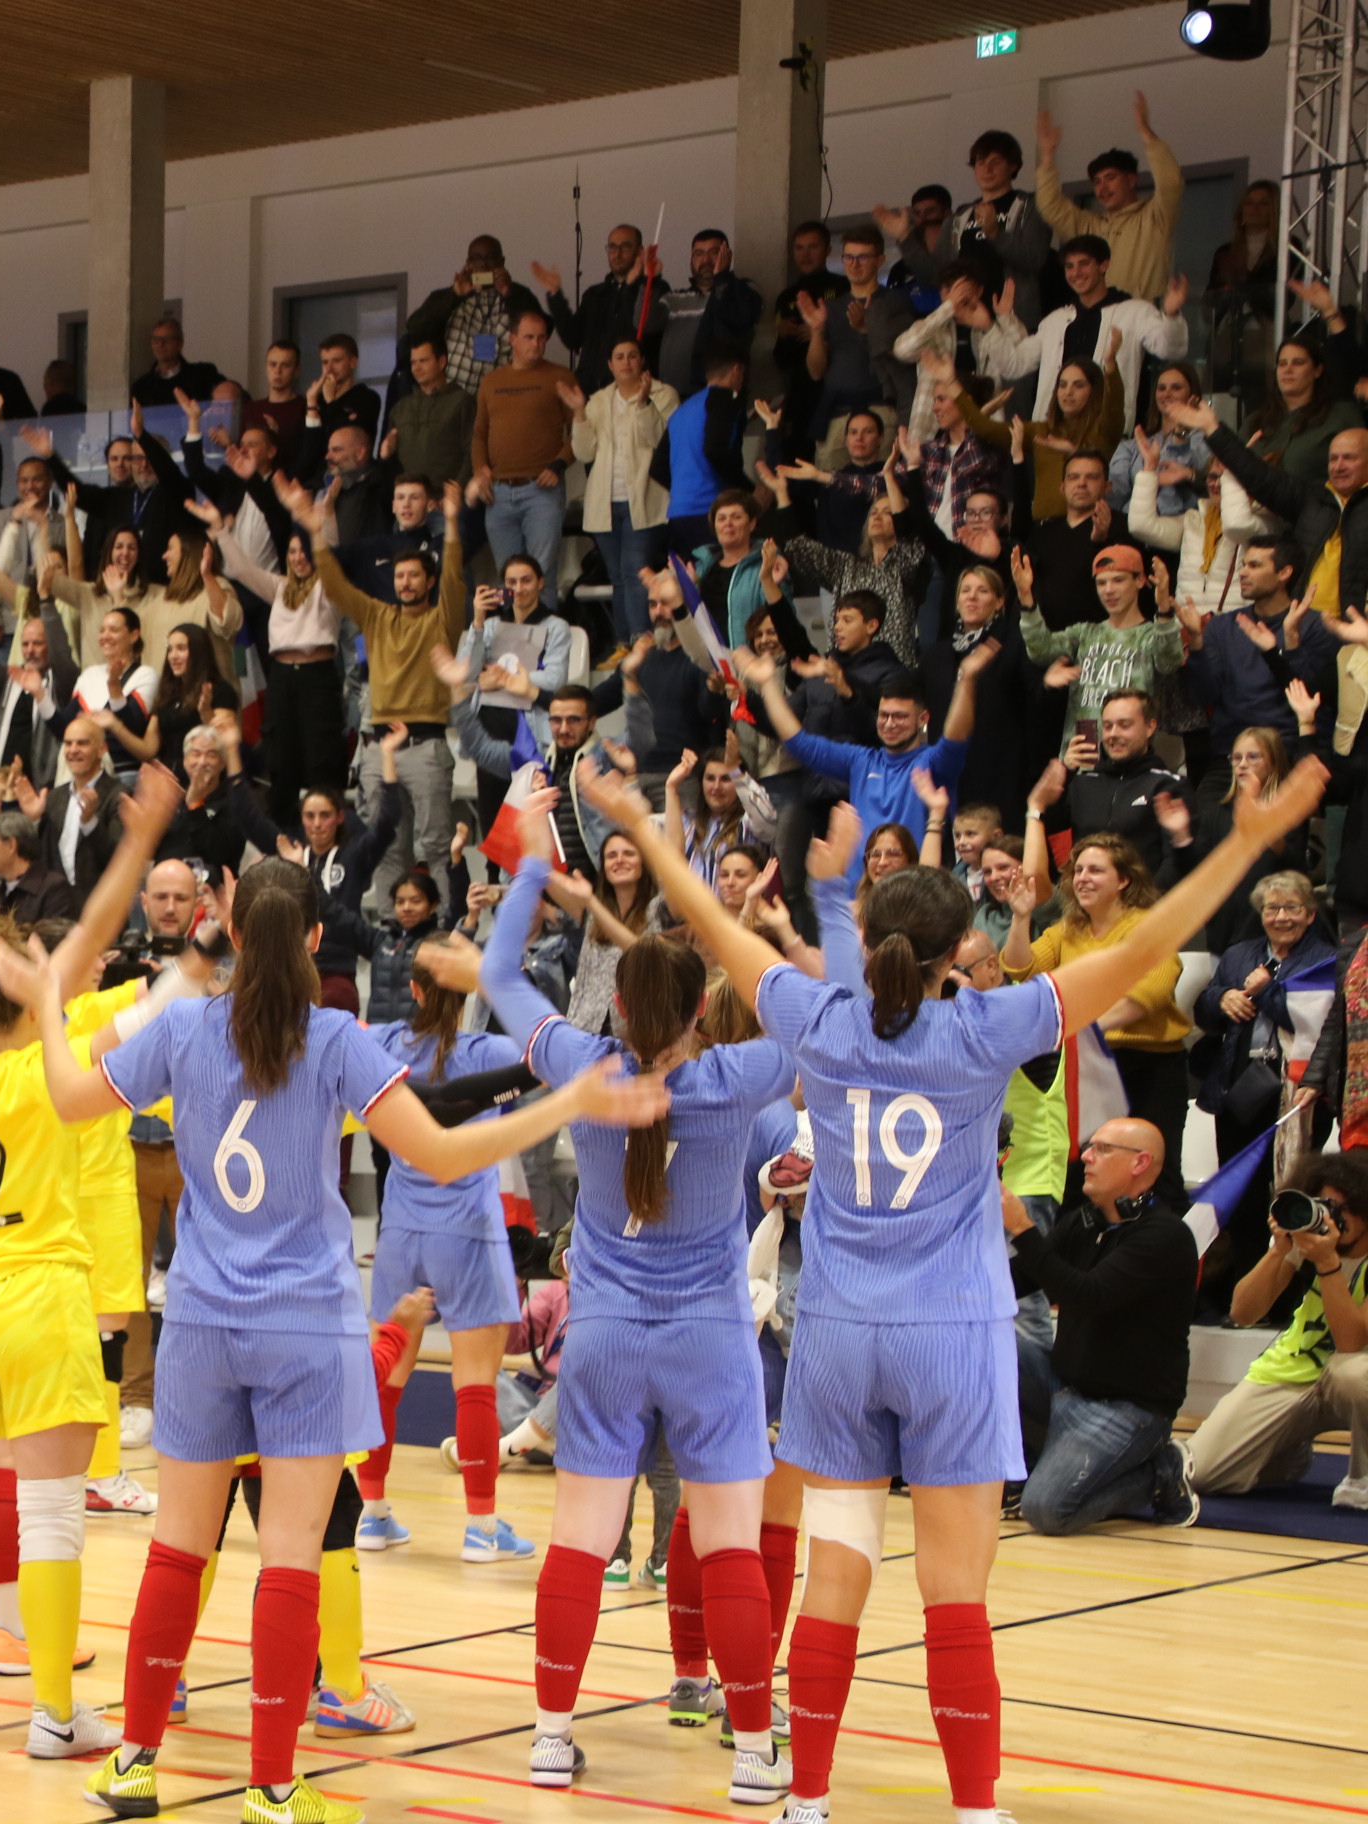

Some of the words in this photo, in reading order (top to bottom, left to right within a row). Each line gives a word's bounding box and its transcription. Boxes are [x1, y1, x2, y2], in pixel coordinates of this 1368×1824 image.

[1079, 656, 1134, 689] BEACH
[213, 1099, 265, 1214] 6
[846, 1087, 943, 1210] 19
[932, 1706, 991, 1720] France
